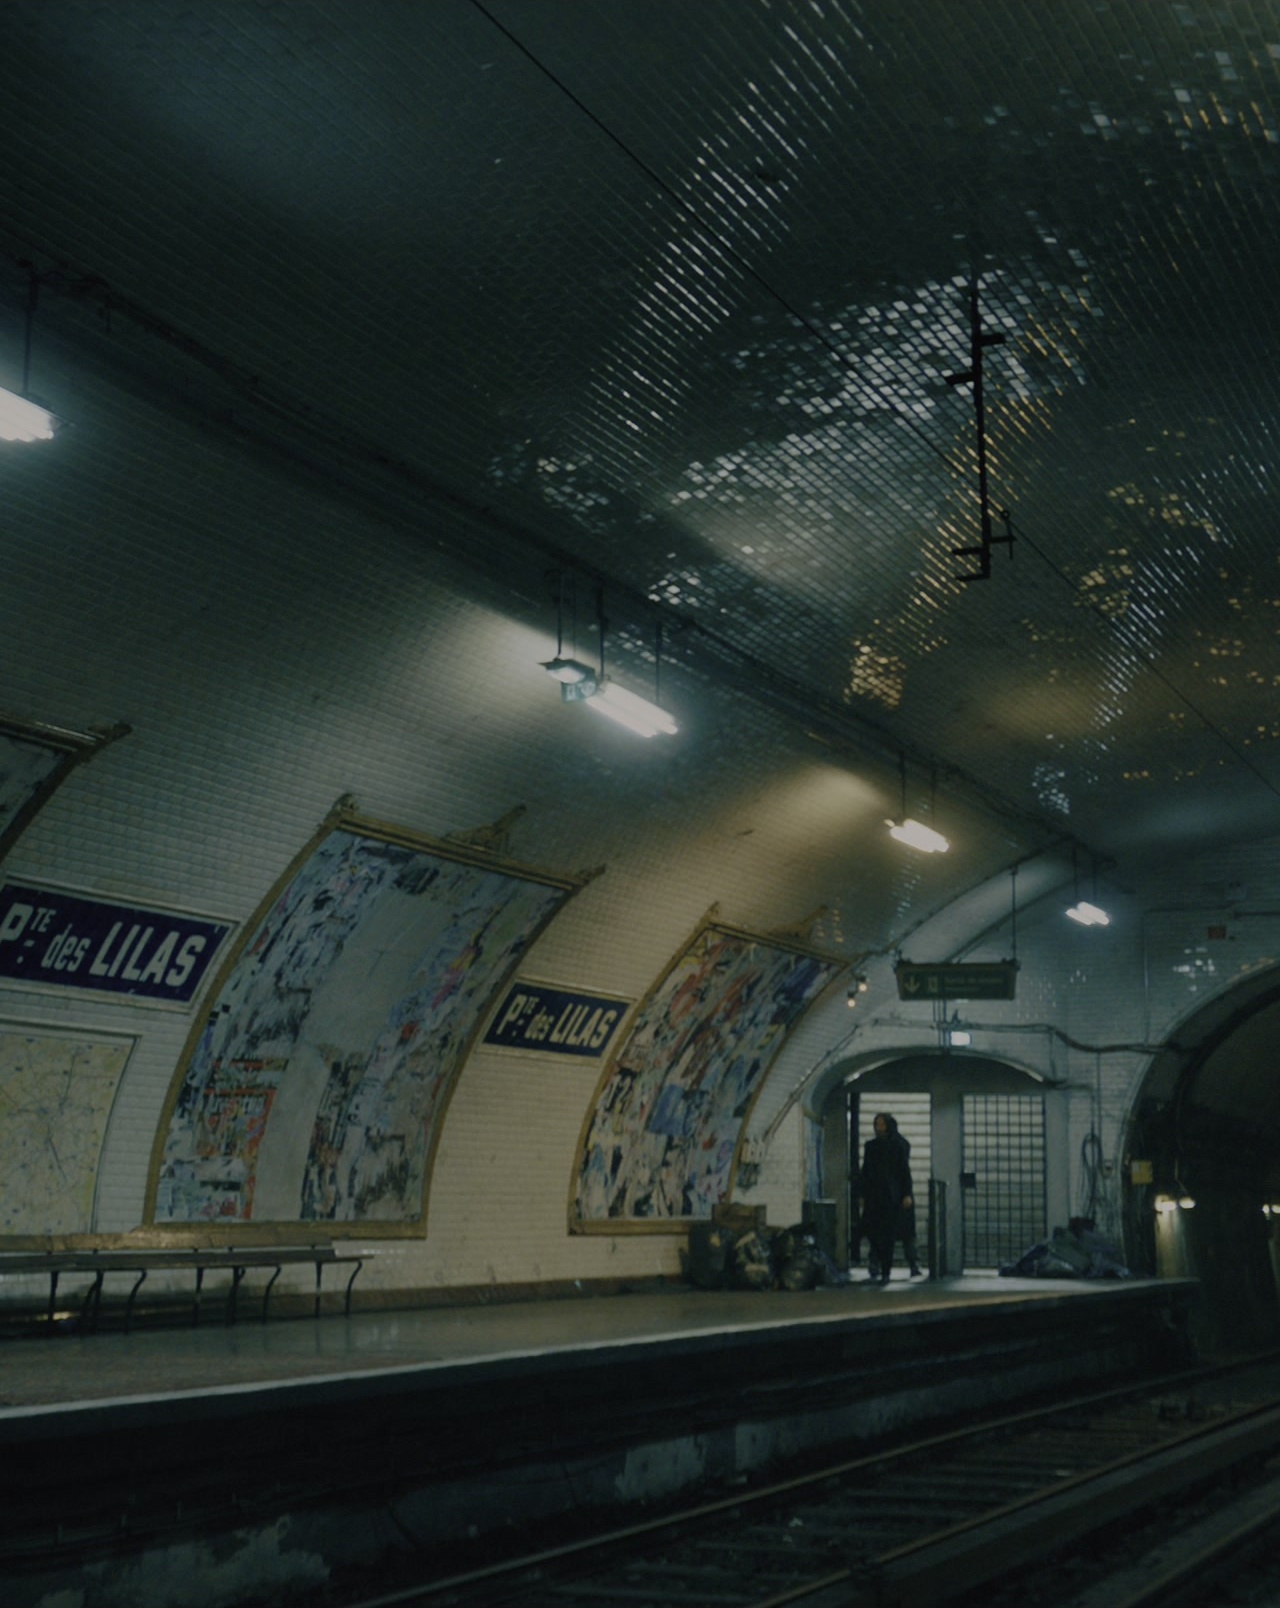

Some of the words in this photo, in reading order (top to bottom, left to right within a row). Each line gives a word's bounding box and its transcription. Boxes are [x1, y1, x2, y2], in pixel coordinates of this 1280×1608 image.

[40, 923, 91, 972] des
[89, 921, 207, 988] LILAS
[524, 1005, 555, 1041] des
[548, 1003, 617, 1049] LILAS
